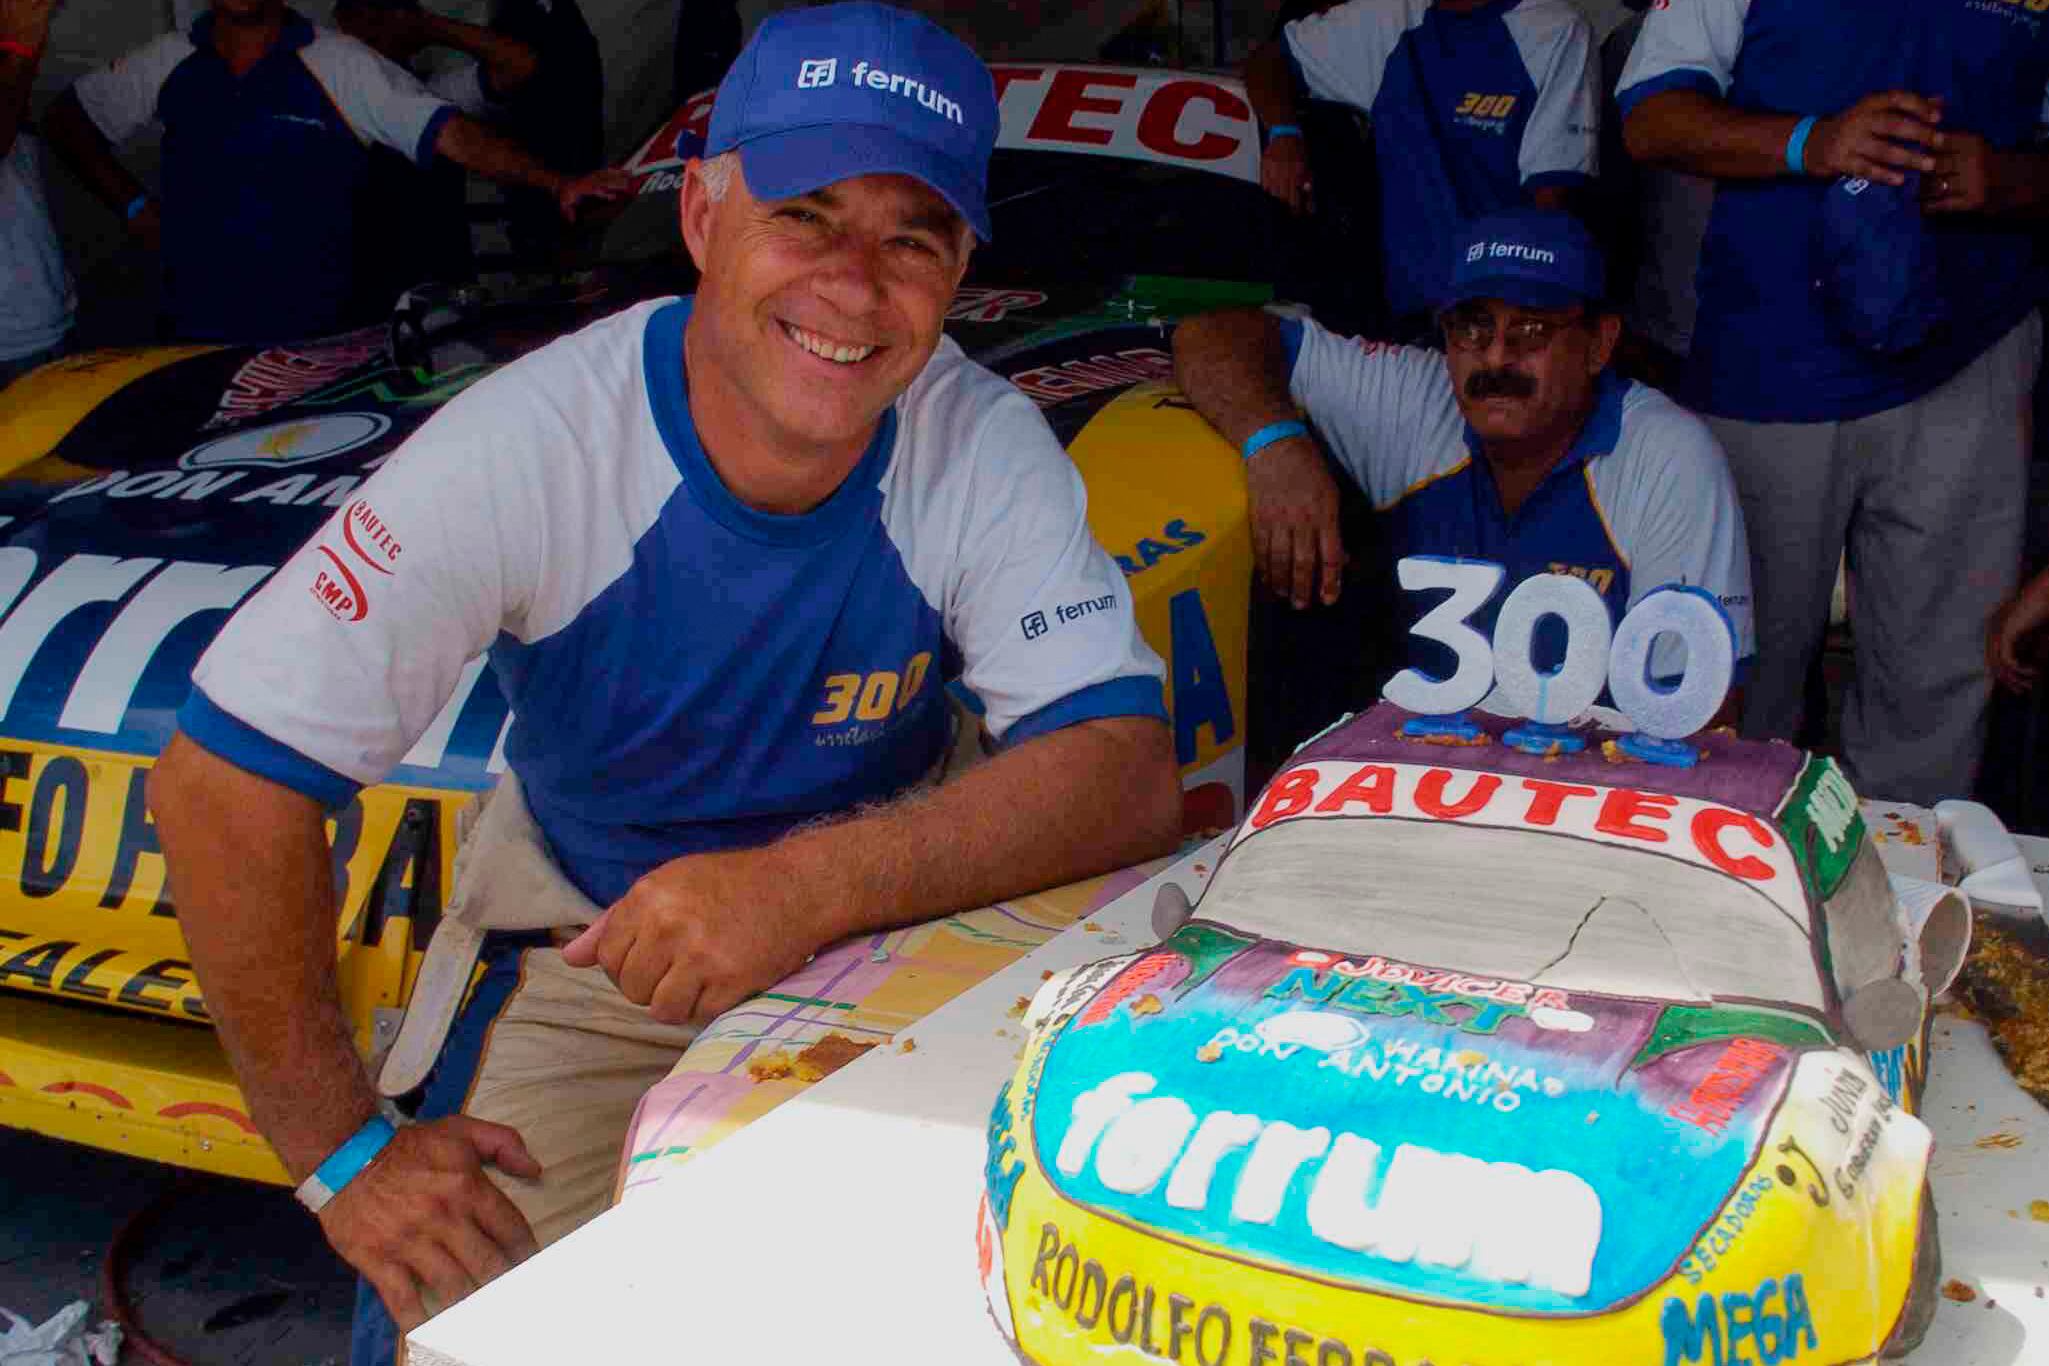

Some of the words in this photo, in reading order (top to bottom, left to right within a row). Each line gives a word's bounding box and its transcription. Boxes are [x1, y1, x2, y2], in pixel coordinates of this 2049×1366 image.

[852, 61, 964, 125] ferrum
[1455, 92, 1518, 118] 300
[1488, 241, 1555, 264] ferrum
[353, 499, 402, 562] BAUTEC
[313, 570, 354, 612] CMP
[1054, 593, 1119, 626] ferrum
[1382, 553, 1738, 741] 300
[811, 651, 934, 725] 300
[1251, 764, 1777, 881] BAUTEC
[1263, 967, 1530, 1035] NEXT
[1317, 1050, 1522, 1112] ANTONIO
[1030, 1221, 1233, 1366] RODOLFO
[1660, 1272, 1819, 1366] MEGA
